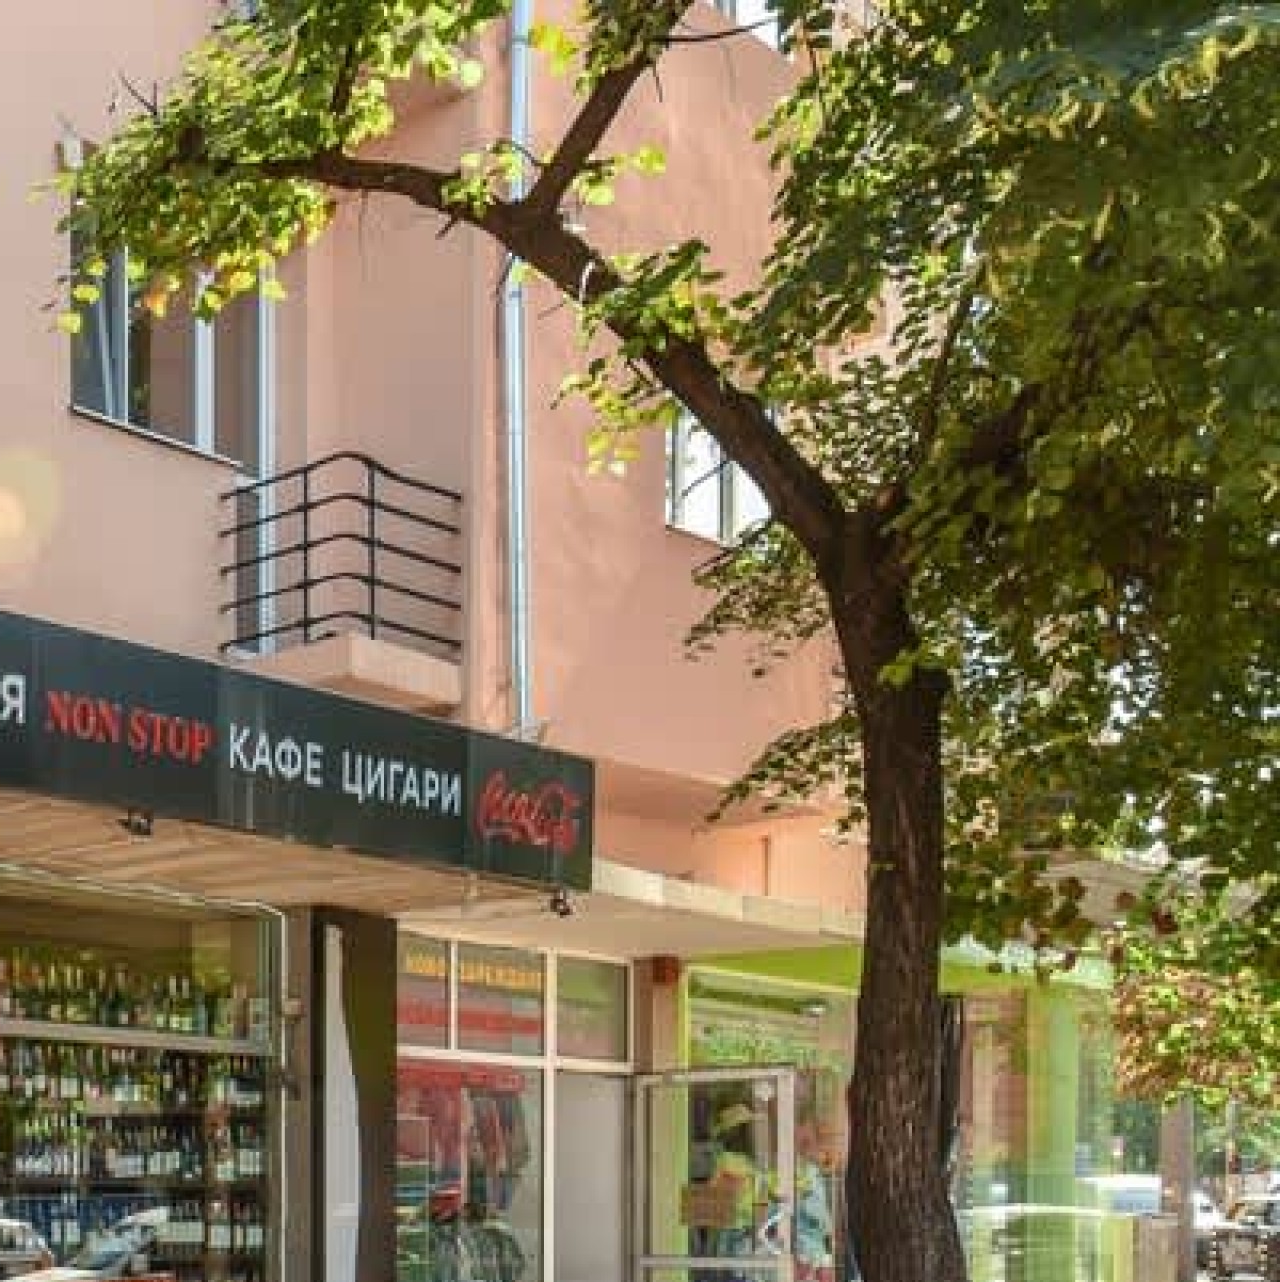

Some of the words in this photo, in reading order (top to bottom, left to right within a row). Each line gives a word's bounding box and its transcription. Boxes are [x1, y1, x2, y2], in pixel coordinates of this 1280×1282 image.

[45, 690, 121, 744] NON
[127, 707, 217, 765] STOP
[228, 722, 325, 787] КАФЕ
[341, 748, 462, 817] ЦИГАРИ
